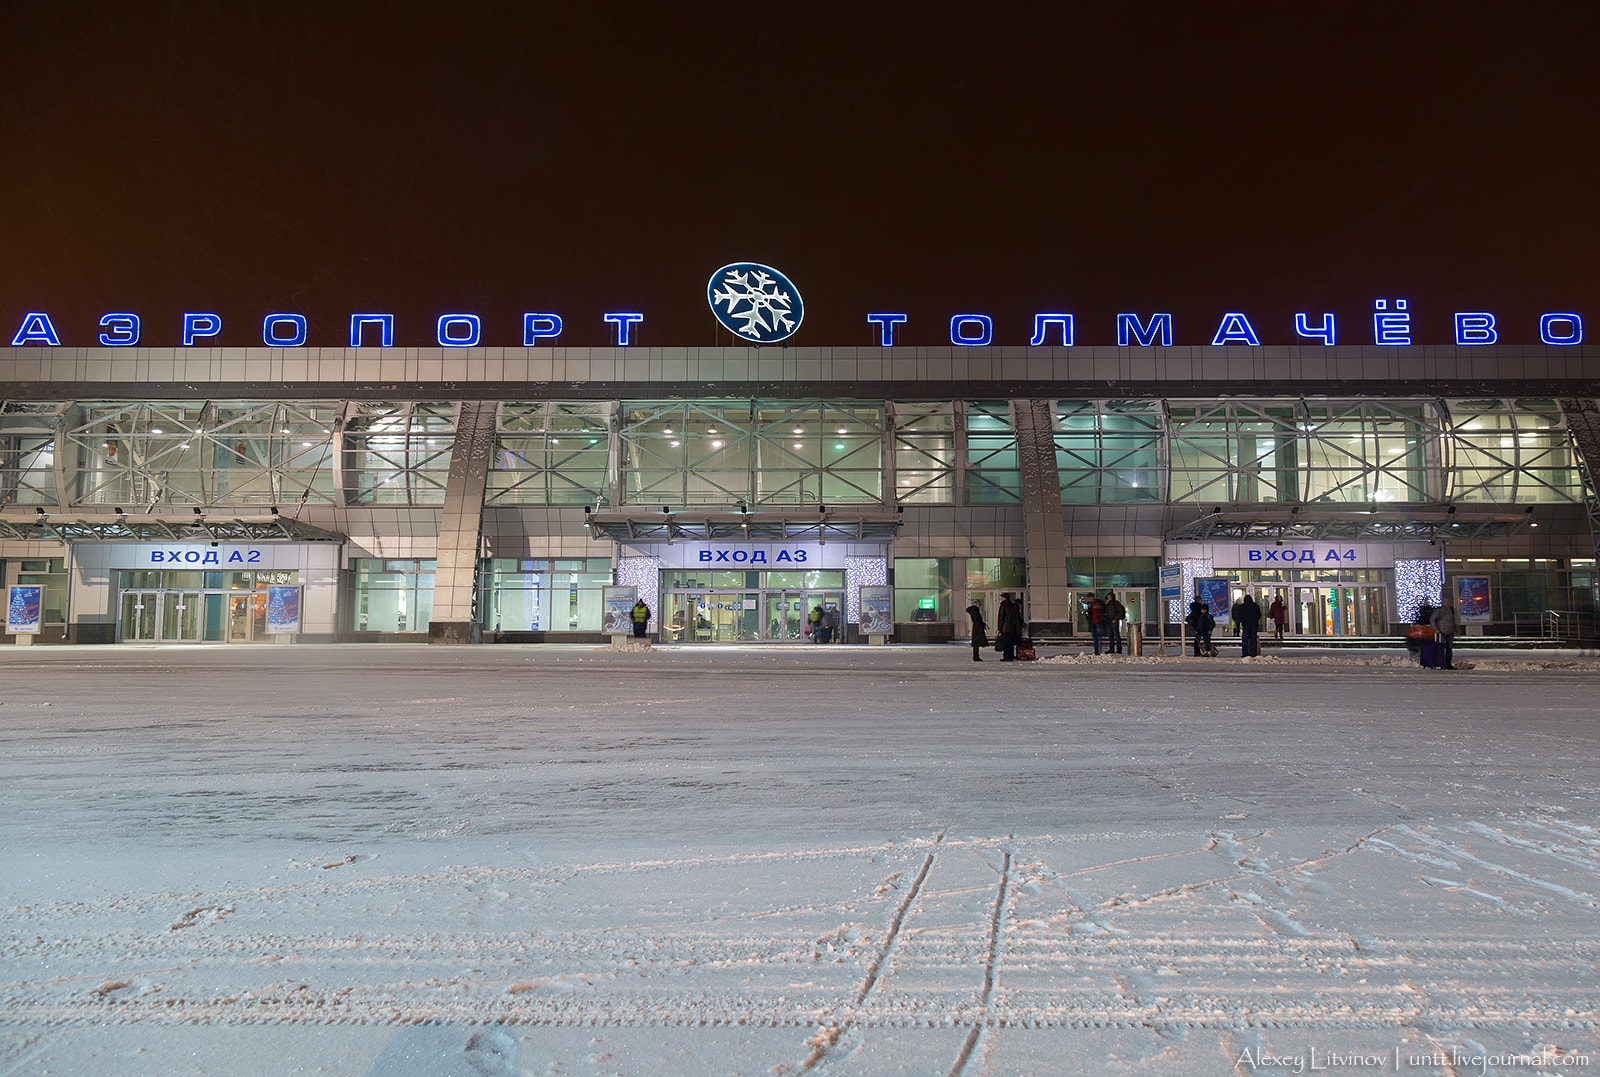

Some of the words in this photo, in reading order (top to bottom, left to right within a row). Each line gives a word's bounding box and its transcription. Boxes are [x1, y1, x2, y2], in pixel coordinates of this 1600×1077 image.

[10, 312, 644, 348] АЭРОПОРТ
[867, 298, 1585, 347] ТОЛМАЧЁВО
[150, 550, 220, 566] ВХОД
[227, 549, 262, 563] А2
[698, 549, 768, 565] ВХОД
[776, 549, 808, 563] А3
[1248, 548, 1316, 564] ВХОД
[1324, 548, 1357, 562] А4
